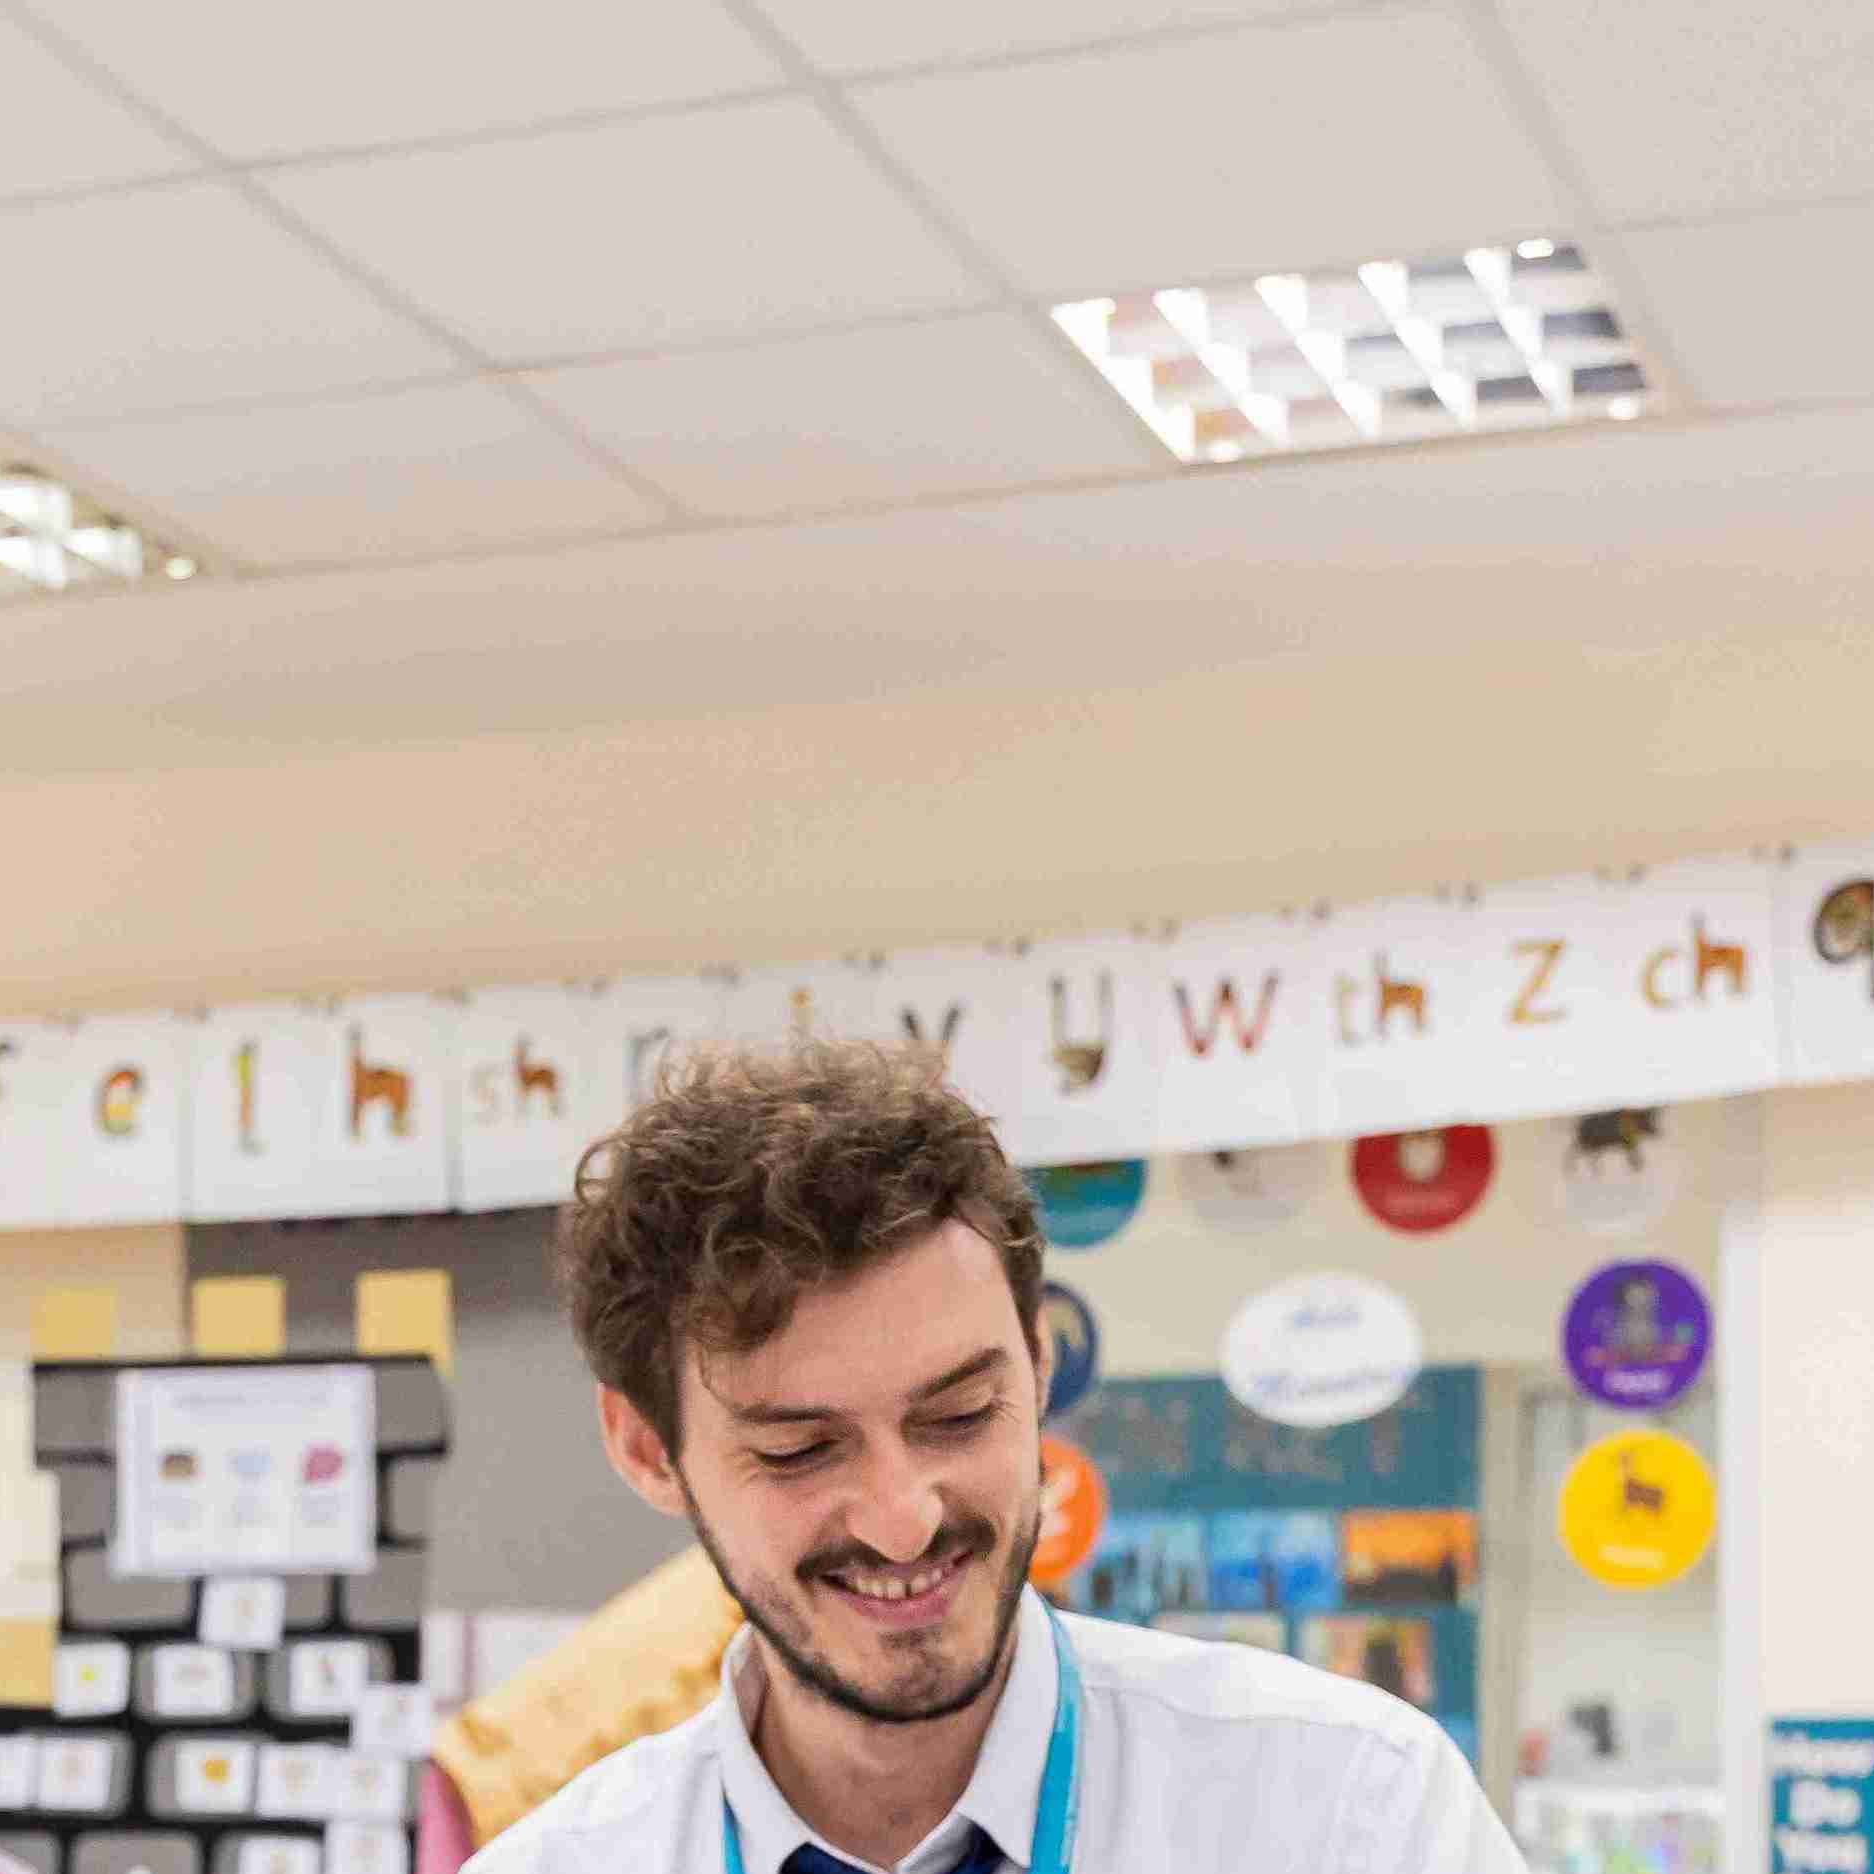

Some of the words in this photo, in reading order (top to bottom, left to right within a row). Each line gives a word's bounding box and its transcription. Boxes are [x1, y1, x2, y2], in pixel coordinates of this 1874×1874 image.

[95, 1064, 148, 1139] e
[349, 1023, 412, 1139] h
[1640, 911, 1747, 1009] ch
